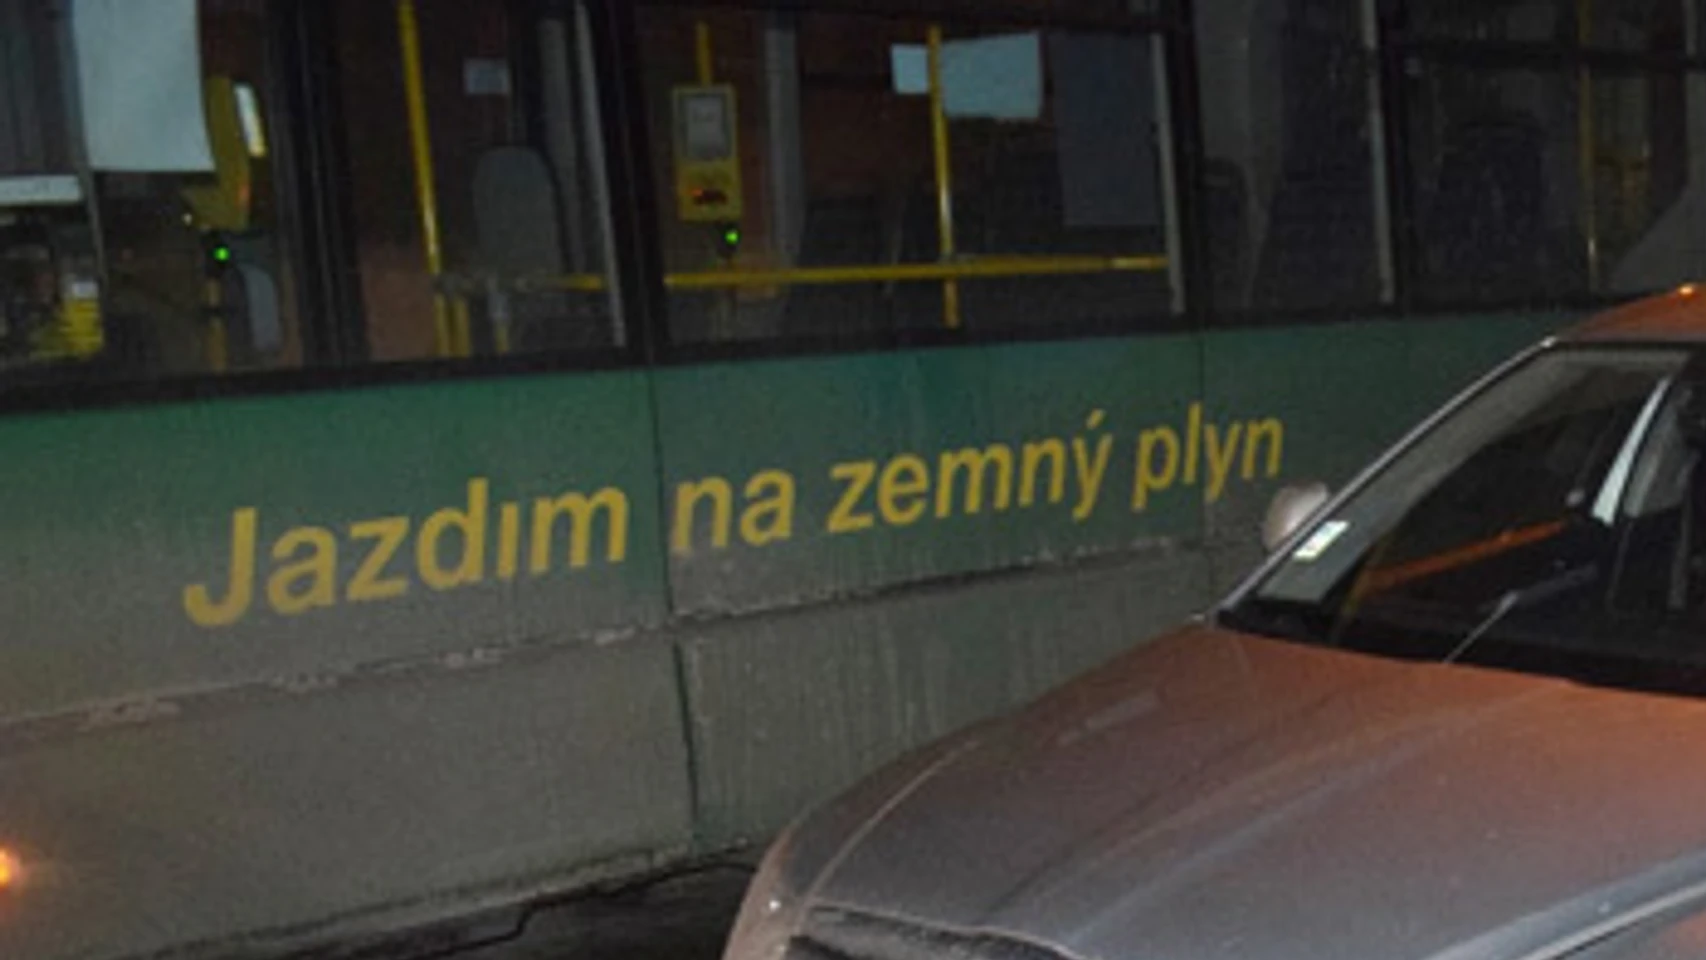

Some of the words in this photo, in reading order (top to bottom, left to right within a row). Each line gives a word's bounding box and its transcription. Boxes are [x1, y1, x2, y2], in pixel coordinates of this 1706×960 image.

[671, 475, 794, 555] na
[828, 410, 1112, 535] zemný
[1132, 403, 1283, 511] plyn
